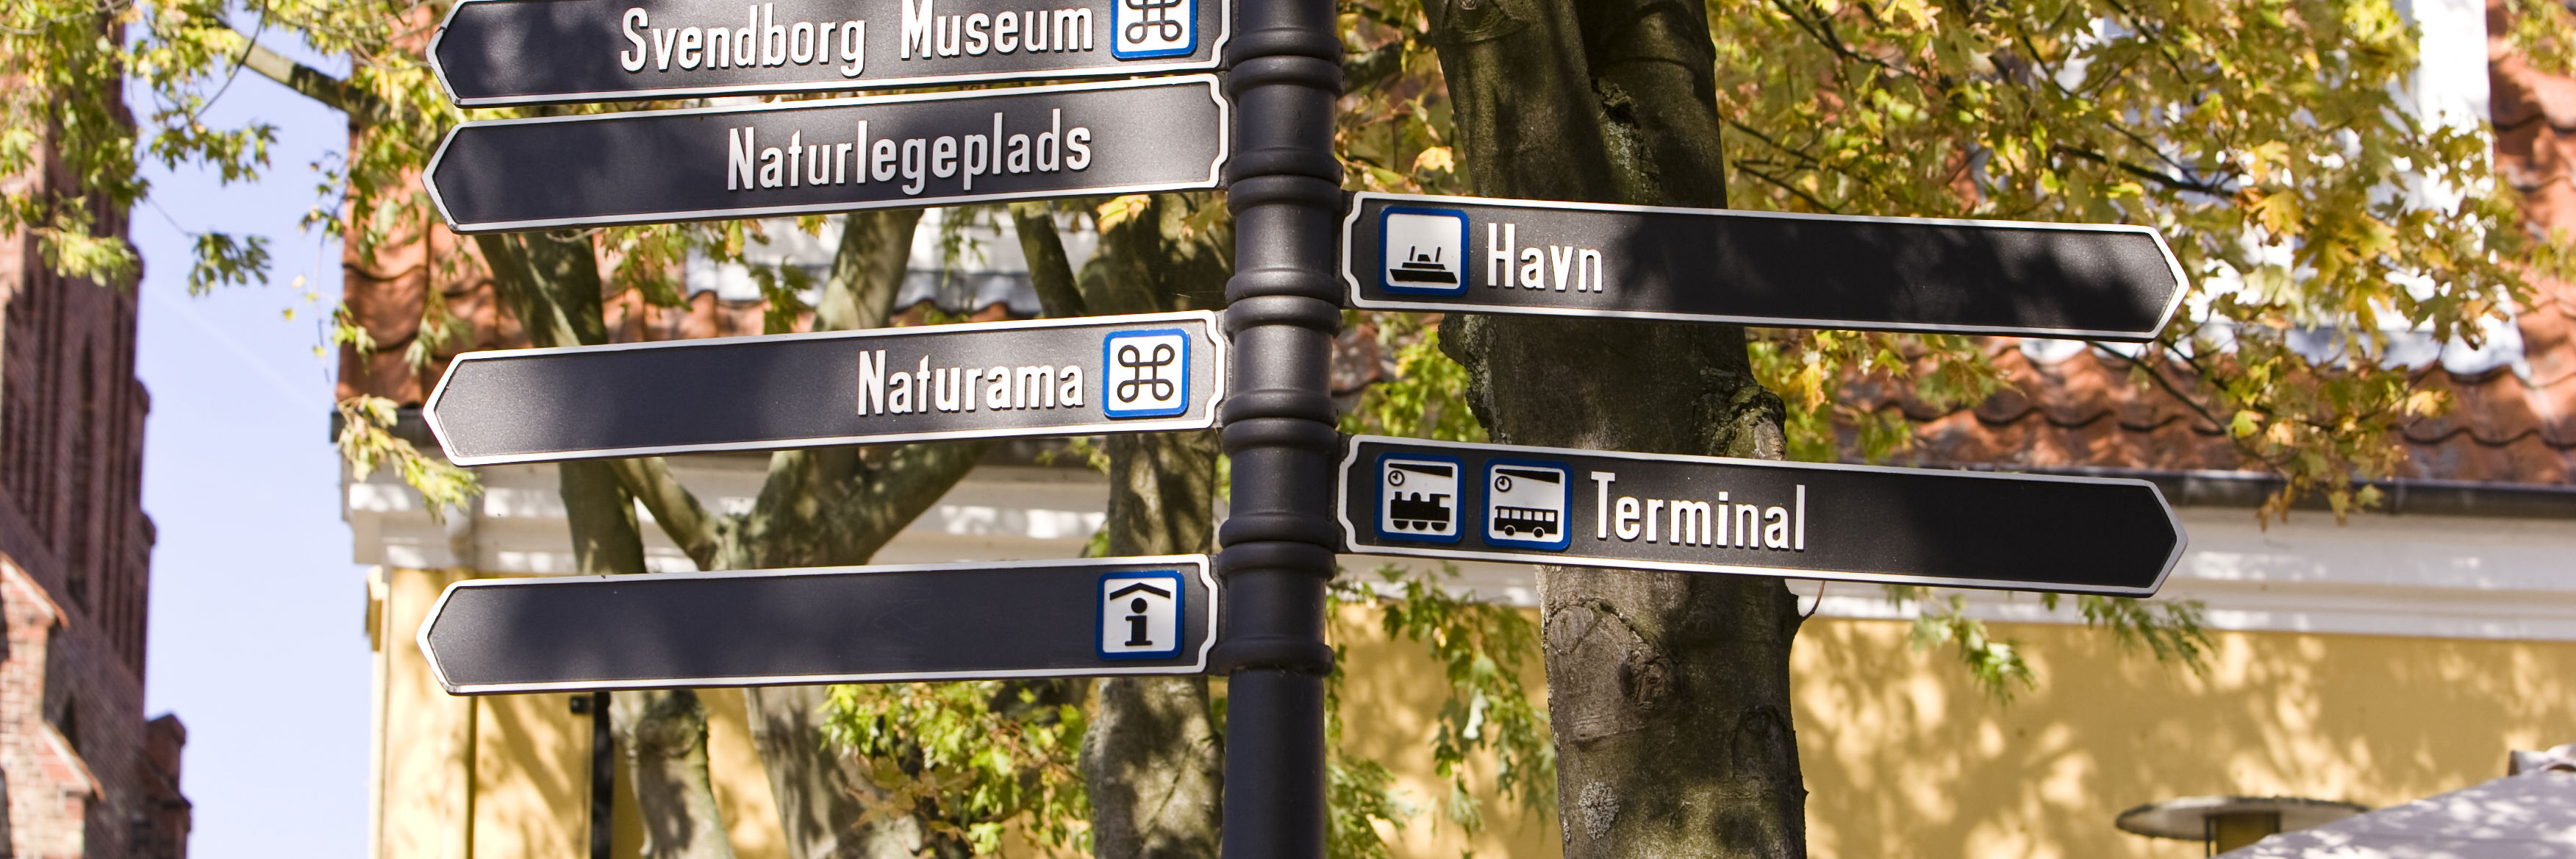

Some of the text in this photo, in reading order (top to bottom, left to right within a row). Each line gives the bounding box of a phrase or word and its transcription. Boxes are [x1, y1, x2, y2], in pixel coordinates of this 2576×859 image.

[620, 0, 1092, 79] Svendborg Museum
[728, 107, 1091, 195] Naturlegeplads
[1485, 222, 1603, 291] Havn
[857, 349, 1084, 416] Naturama
[1591, 471, 1806, 550] Terminal
